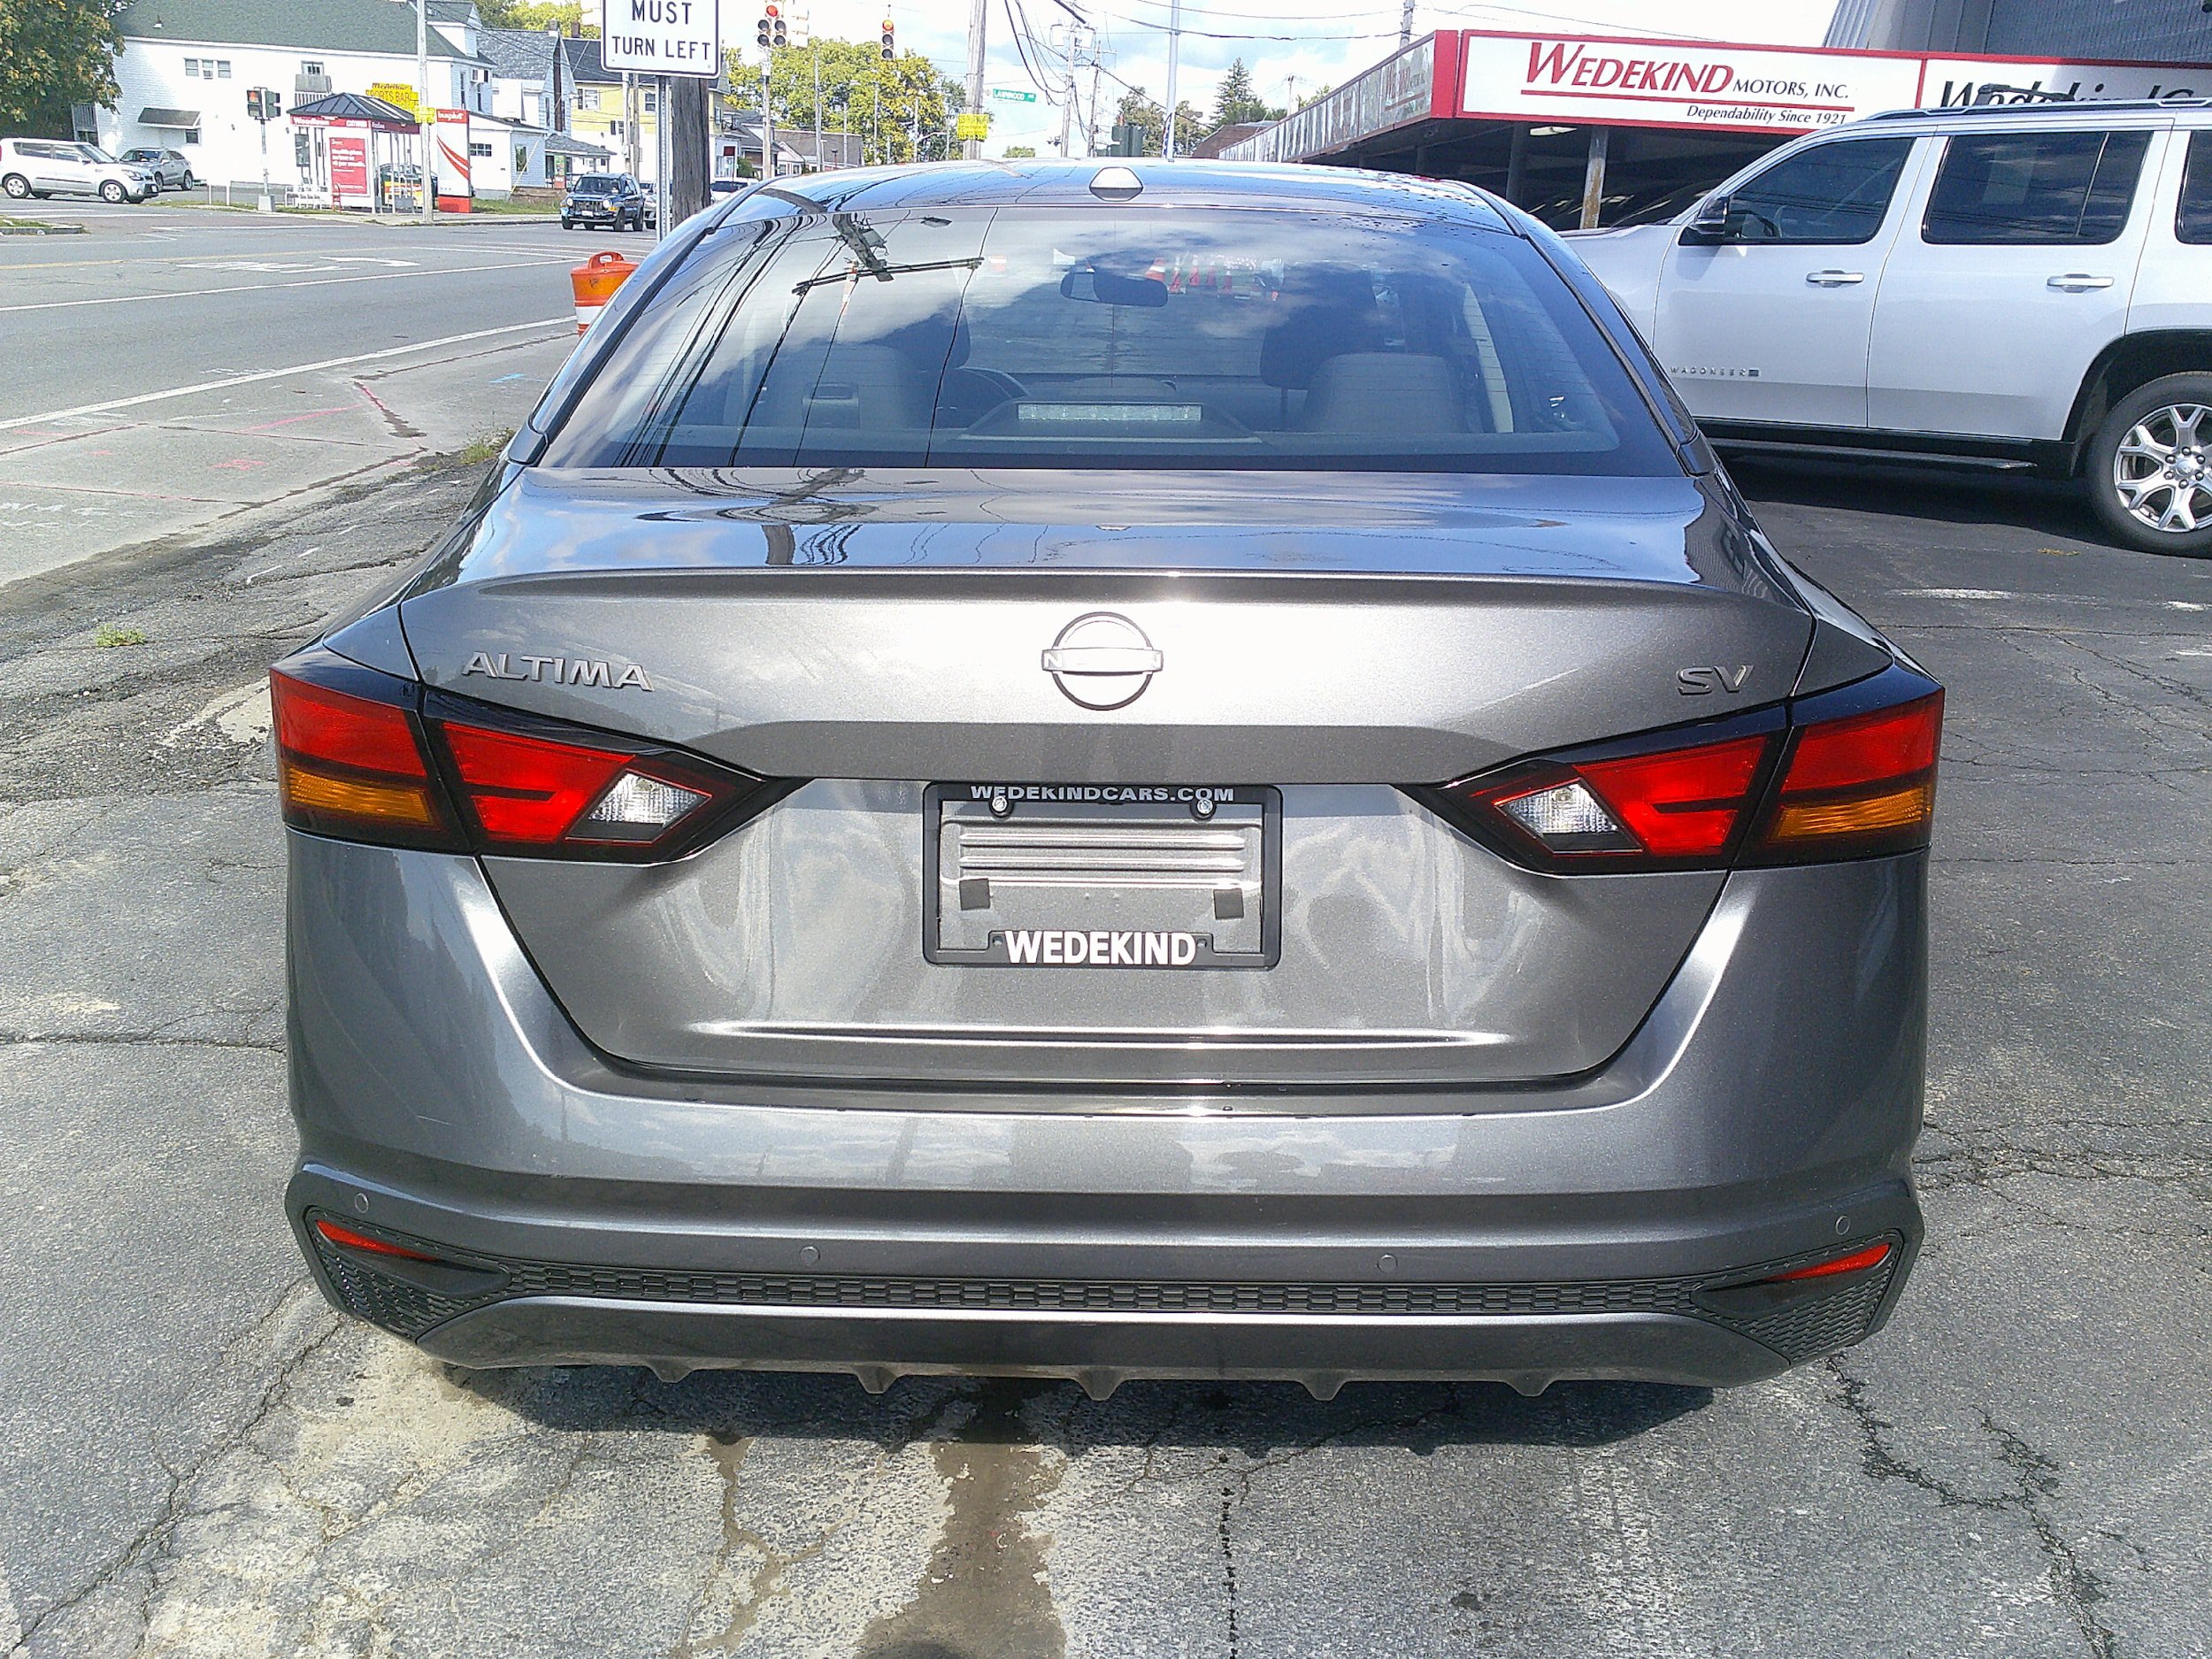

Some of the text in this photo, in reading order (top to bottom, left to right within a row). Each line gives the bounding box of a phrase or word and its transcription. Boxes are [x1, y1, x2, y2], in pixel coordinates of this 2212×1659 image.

[632, 0, 692, 25] MUST
[611, 35, 710, 60] TURN LEFT
[1526, 42, 1849, 98] WEDEKIND MOTORS, INC.
[1686, 104, 1847, 125] Dependability Since 1921
[1670, 365, 1747, 377] WAGONEER
[461, 650, 656, 692] ALTIMA
[1676, 664, 1755, 695] SV
[970, 786, 1234, 803] WEDEKINDCARS.COM
[1004, 930, 1197, 965] WEDEKIND
